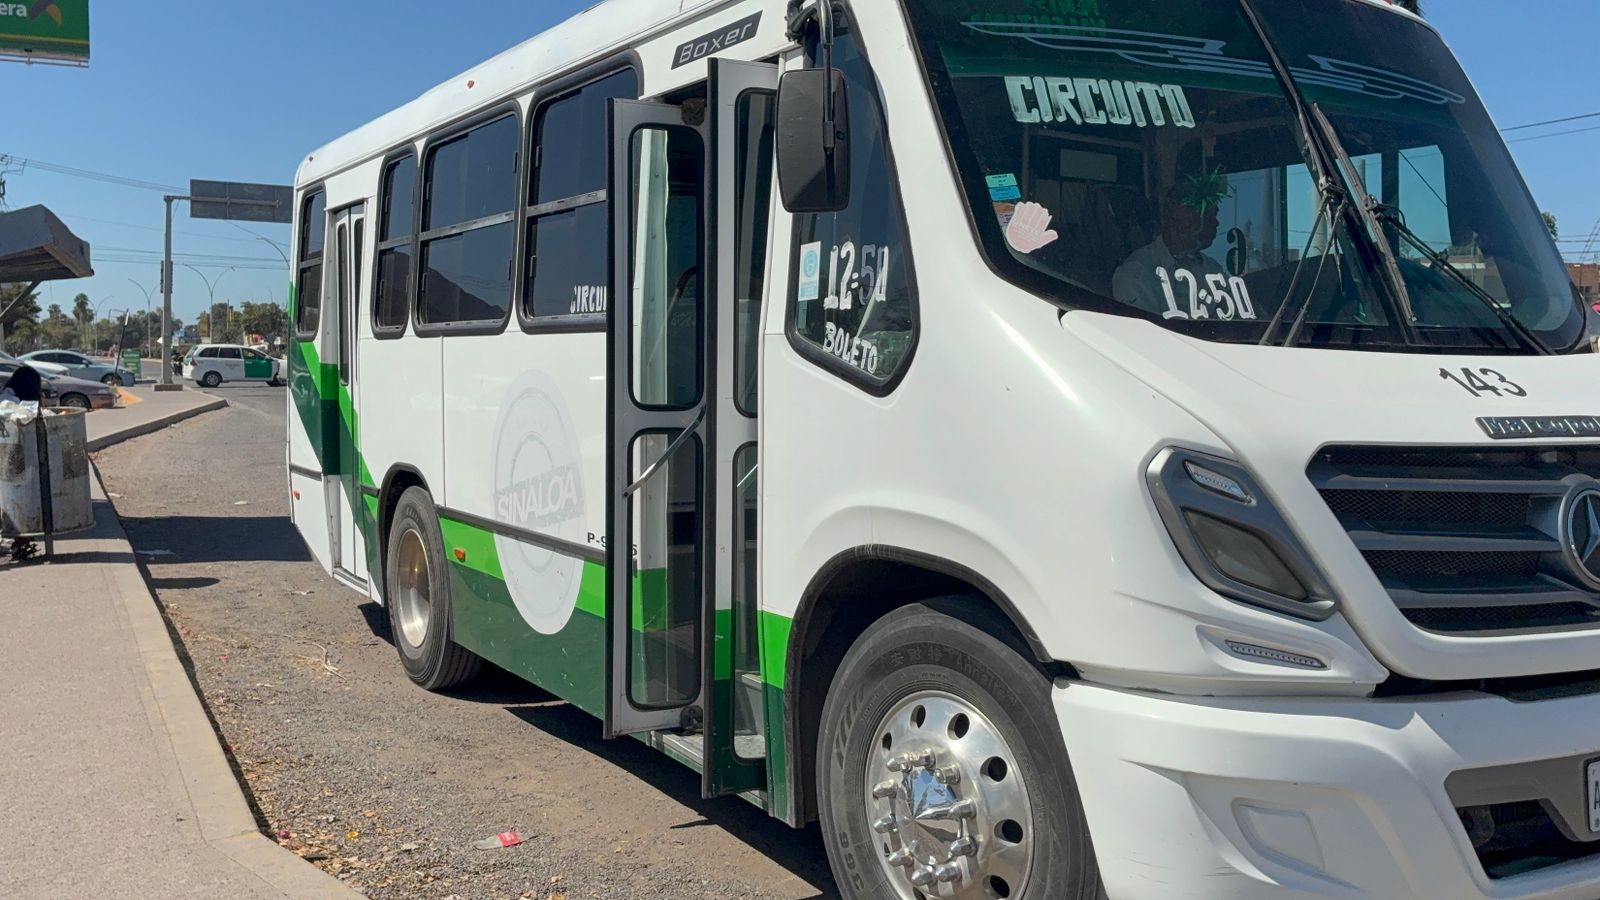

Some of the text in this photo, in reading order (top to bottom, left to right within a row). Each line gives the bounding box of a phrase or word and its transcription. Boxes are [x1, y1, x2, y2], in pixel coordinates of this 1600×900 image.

[0, 2, 27, 17] era
[679, 22, 752, 63] Boxer
[1004, 75, 1196, 128] CIRCUITO
[824, 241, 889, 310] 12:50
[1156, 266, 1256, 320] 12:50
[823, 321, 878, 374] BOLETO
[1439, 367, 1527, 397] 143
[498, 471, 578, 523] SINALOA
